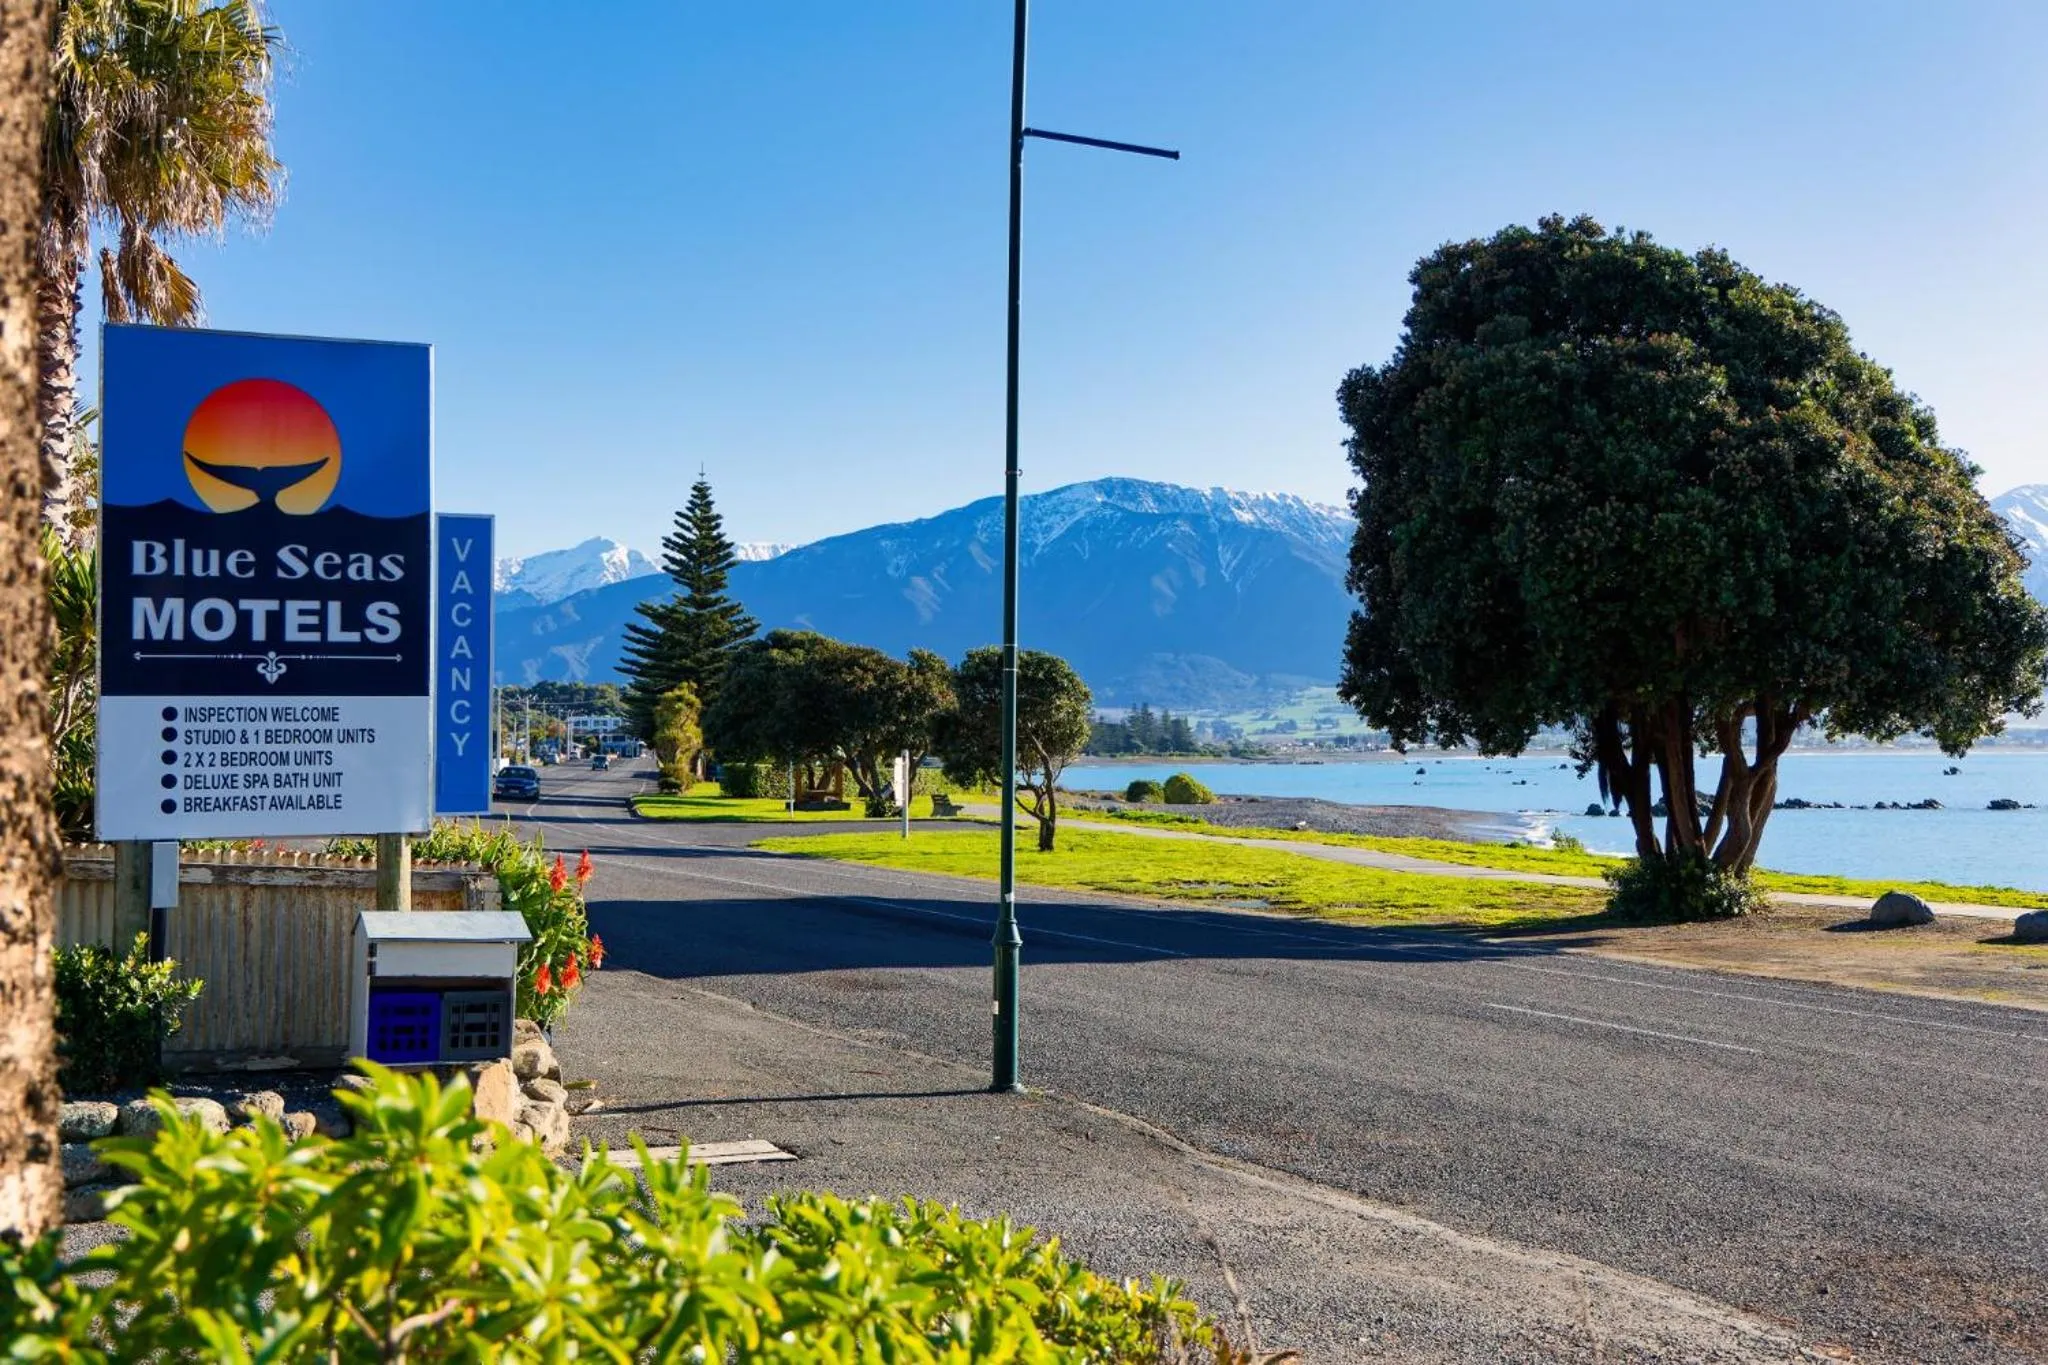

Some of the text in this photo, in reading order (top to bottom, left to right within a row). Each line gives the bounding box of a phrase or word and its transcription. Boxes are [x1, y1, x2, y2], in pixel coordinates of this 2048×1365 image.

[131, 538, 406, 582] Blue Seas
[131, 597, 403, 645] MOTELS
[450, 536, 474, 757] VACANCY
[184, 706, 340, 723] INSPECTION WELCOME
[184, 728, 376, 745] STUDIO & 1 BEDROOM UNITS
[184, 750, 333, 768] 2 X 2 BEDROOM UNITS
[184, 772, 343, 790] DELUXE SPA BATH UNIT
[184, 794, 343, 813] BREAKFAST AVAILABLE
